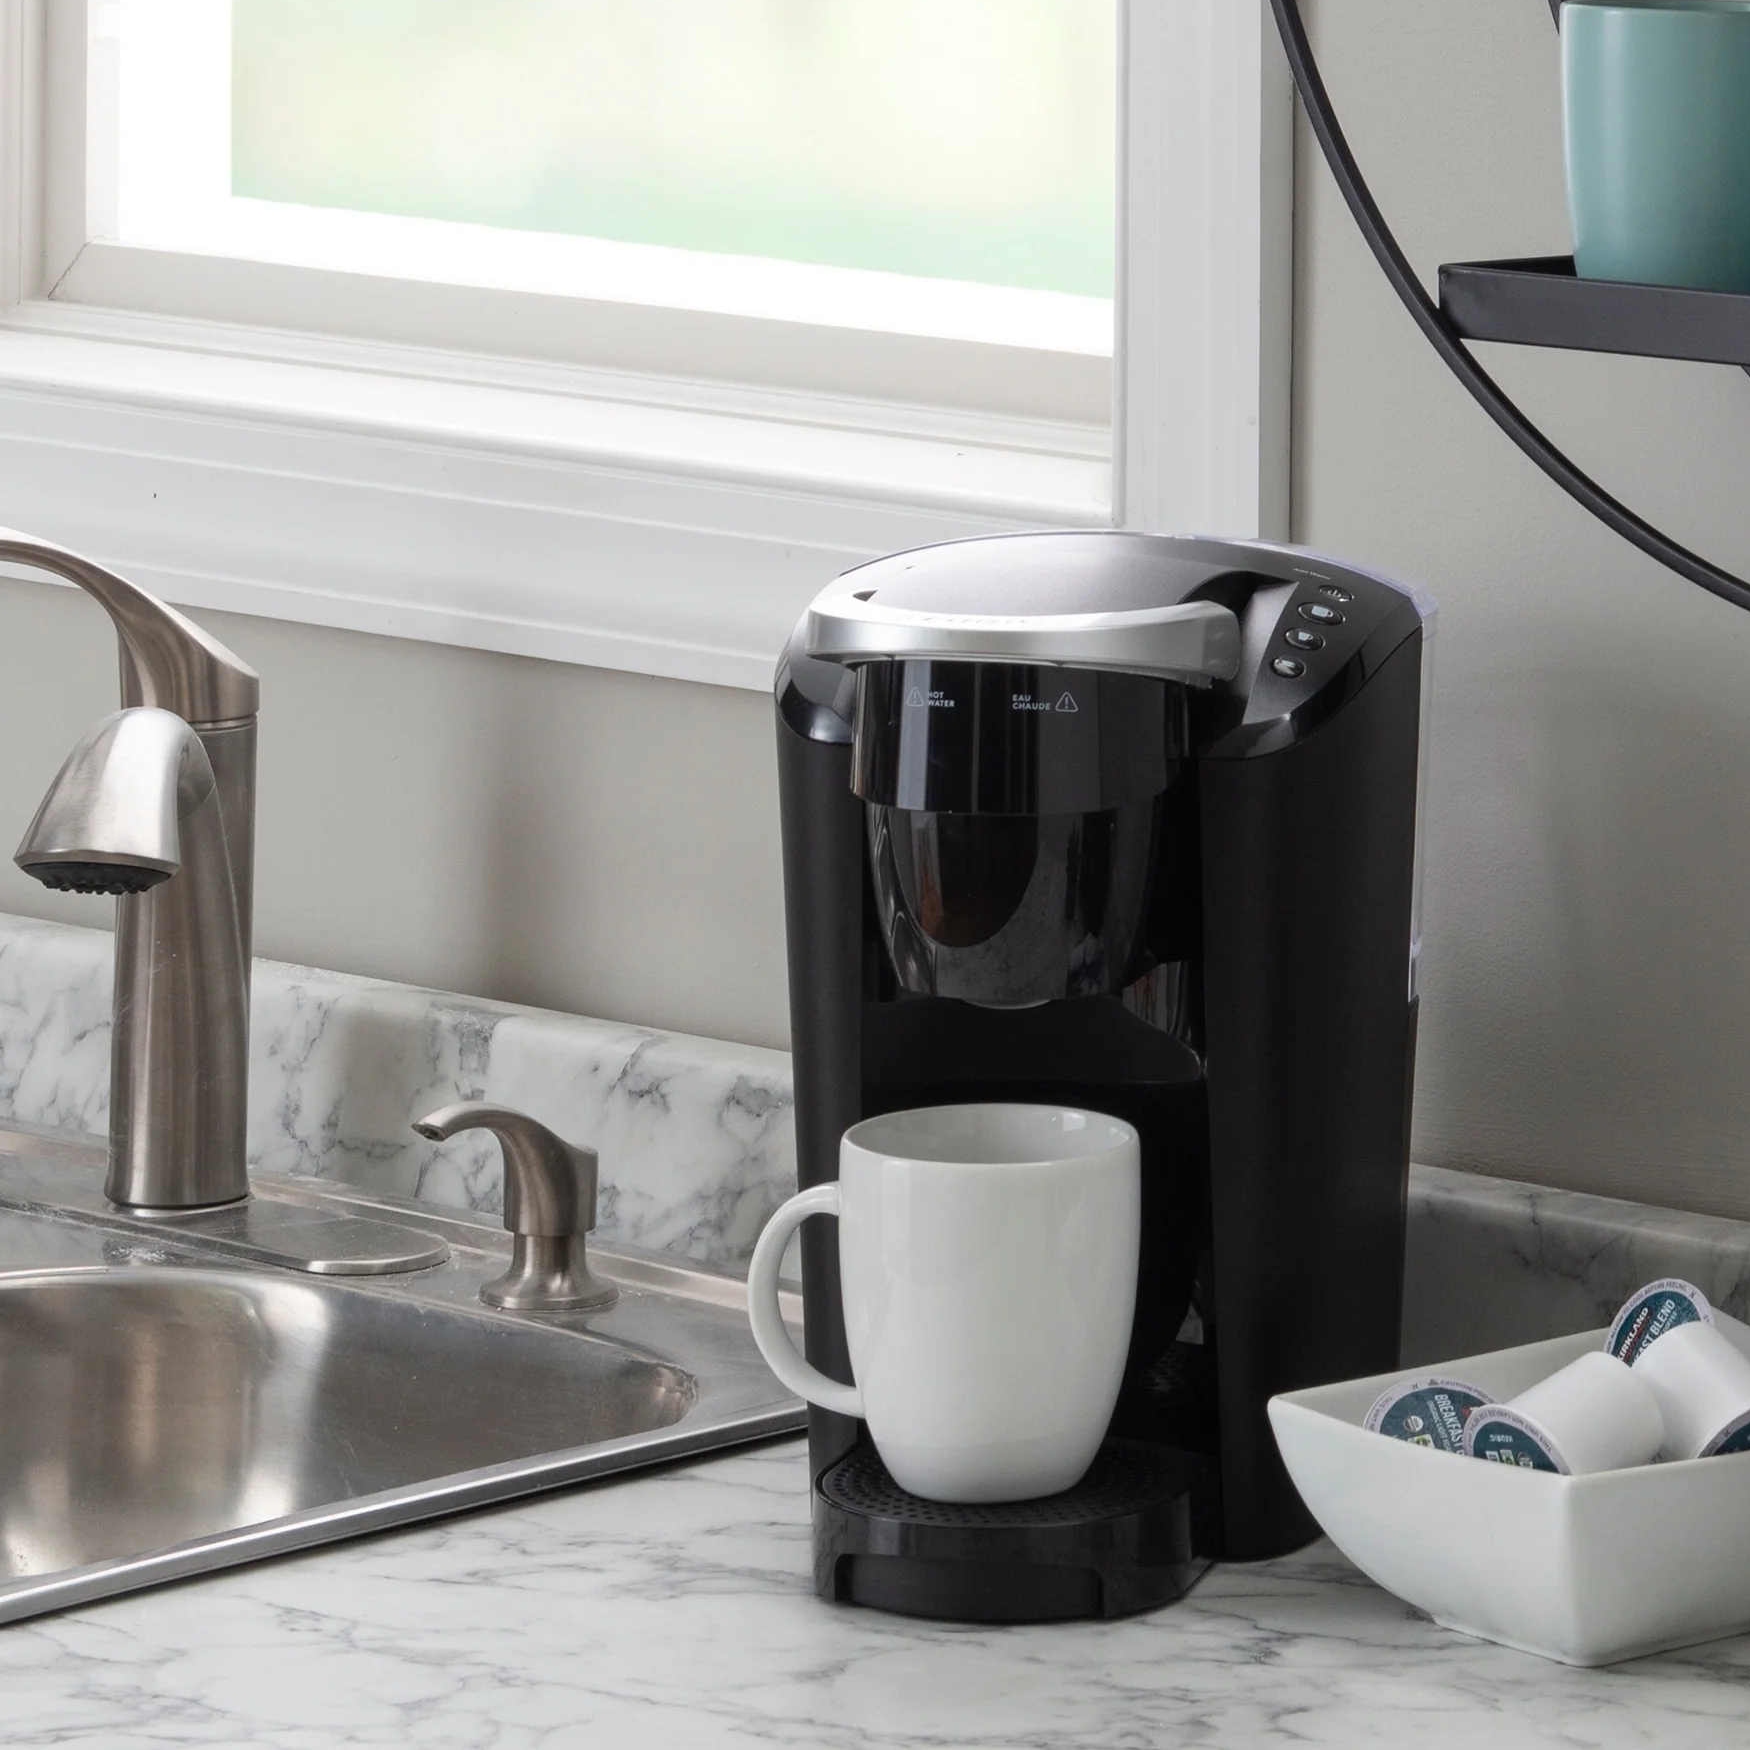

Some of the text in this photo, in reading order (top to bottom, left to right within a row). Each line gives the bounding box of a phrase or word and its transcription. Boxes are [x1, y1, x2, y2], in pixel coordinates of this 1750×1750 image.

[928, 691, 944, 699] HOT
[1012, 694, 1031, 702] EAU
[928, 699, 955, 708] WATER
[1012, 702, 1051, 711] CHAUDE
[1649, 1298, 1676, 1336] BLEND
[1617, 1307, 1649, 1361] KIRKLAND
[1434, 1393, 1465, 1448] BREAKFAST
